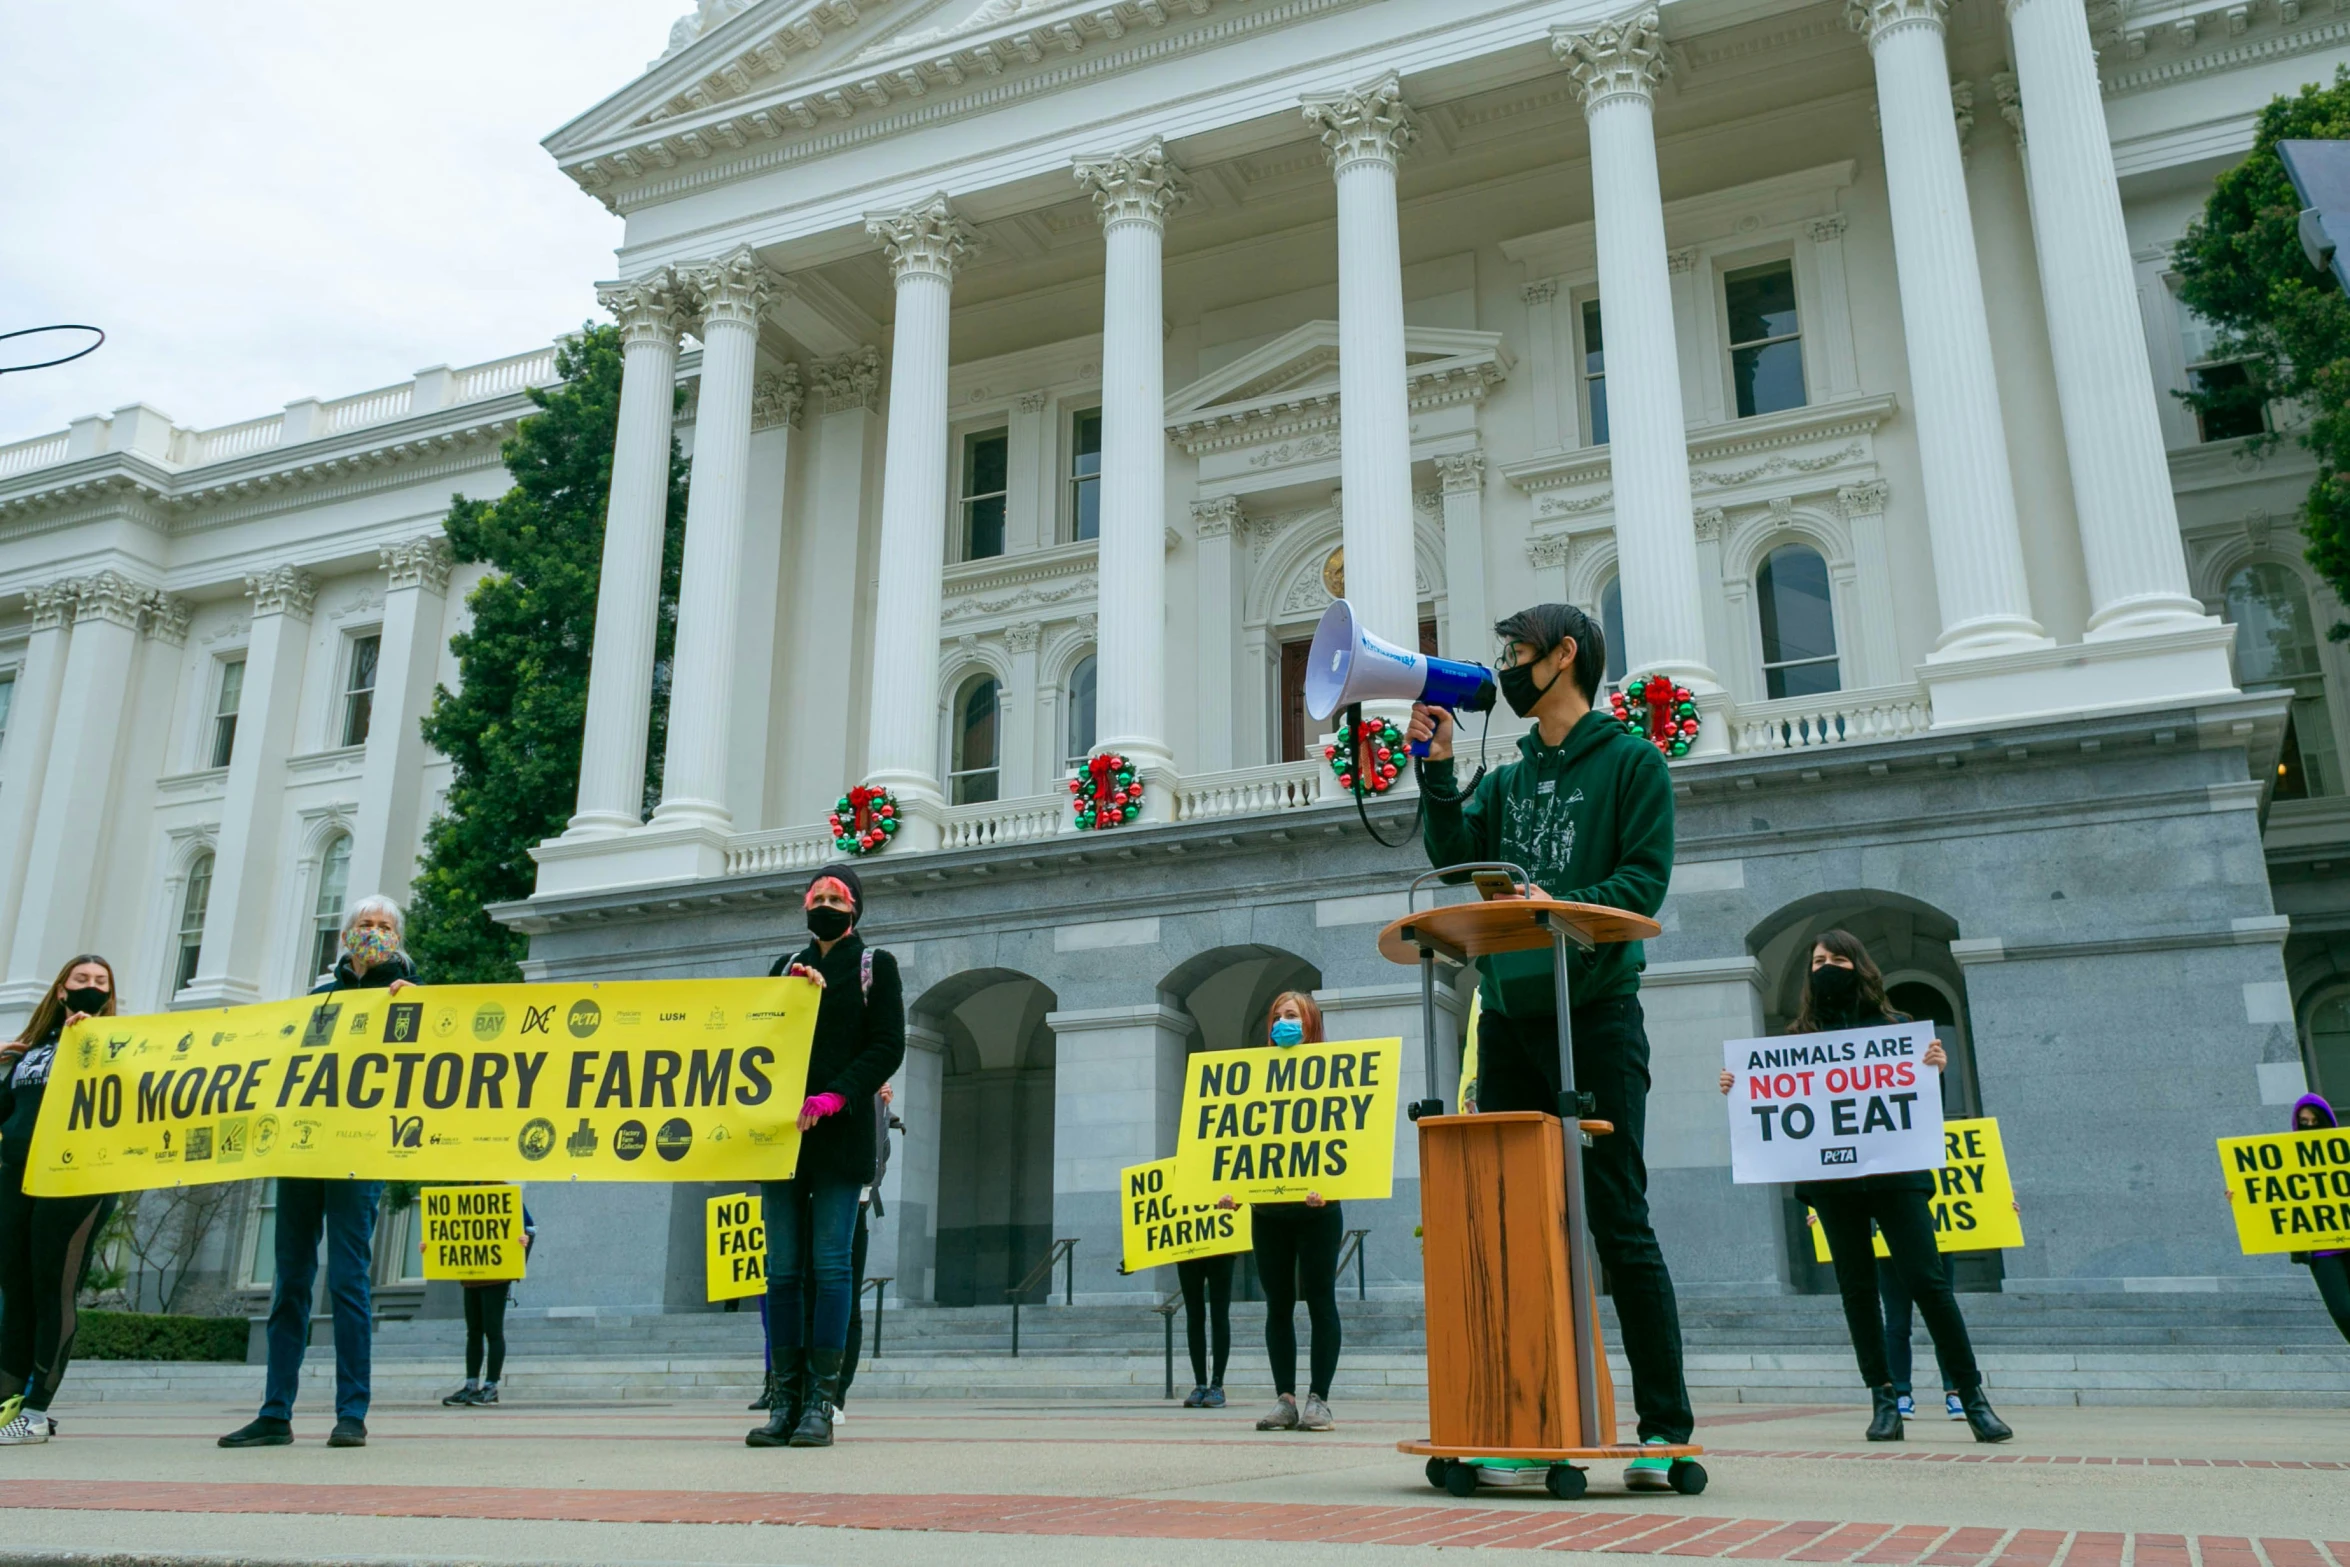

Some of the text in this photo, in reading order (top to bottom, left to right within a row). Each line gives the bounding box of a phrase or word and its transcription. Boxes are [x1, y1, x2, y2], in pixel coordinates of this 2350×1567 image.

[474, 1017, 505, 1033] BAY
[659, 1012, 687, 1021] LUSH
[1747, 1036, 1914, 1070] ANIMALS ARE
[67, 1046, 776, 1131] NO MORE FACTORY FARMS
[1199, 1051, 1382, 1098] NO MORE
[1749, 1061, 1916, 1100] NOT OURS
[1197, 1093, 1375, 1140] FACTORY
[1751, 1092, 1919, 1142] TO EAT
[155, 1150, 167, 1159] EAST
[1212, 1138, 1348, 1182] FARMS
[2234, 1143, 2284, 1173] NO
[1131, 1168, 1164, 1198] NO
[427, 1192, 512, 1216] NO MORE
[717, 1201, 750, 1228] NO
[430, 1218, 511, 1241] FACTORY
[1147, 1213, 1234, 1252] FARMS
[440, 1244, 502, 1267] FARMS
